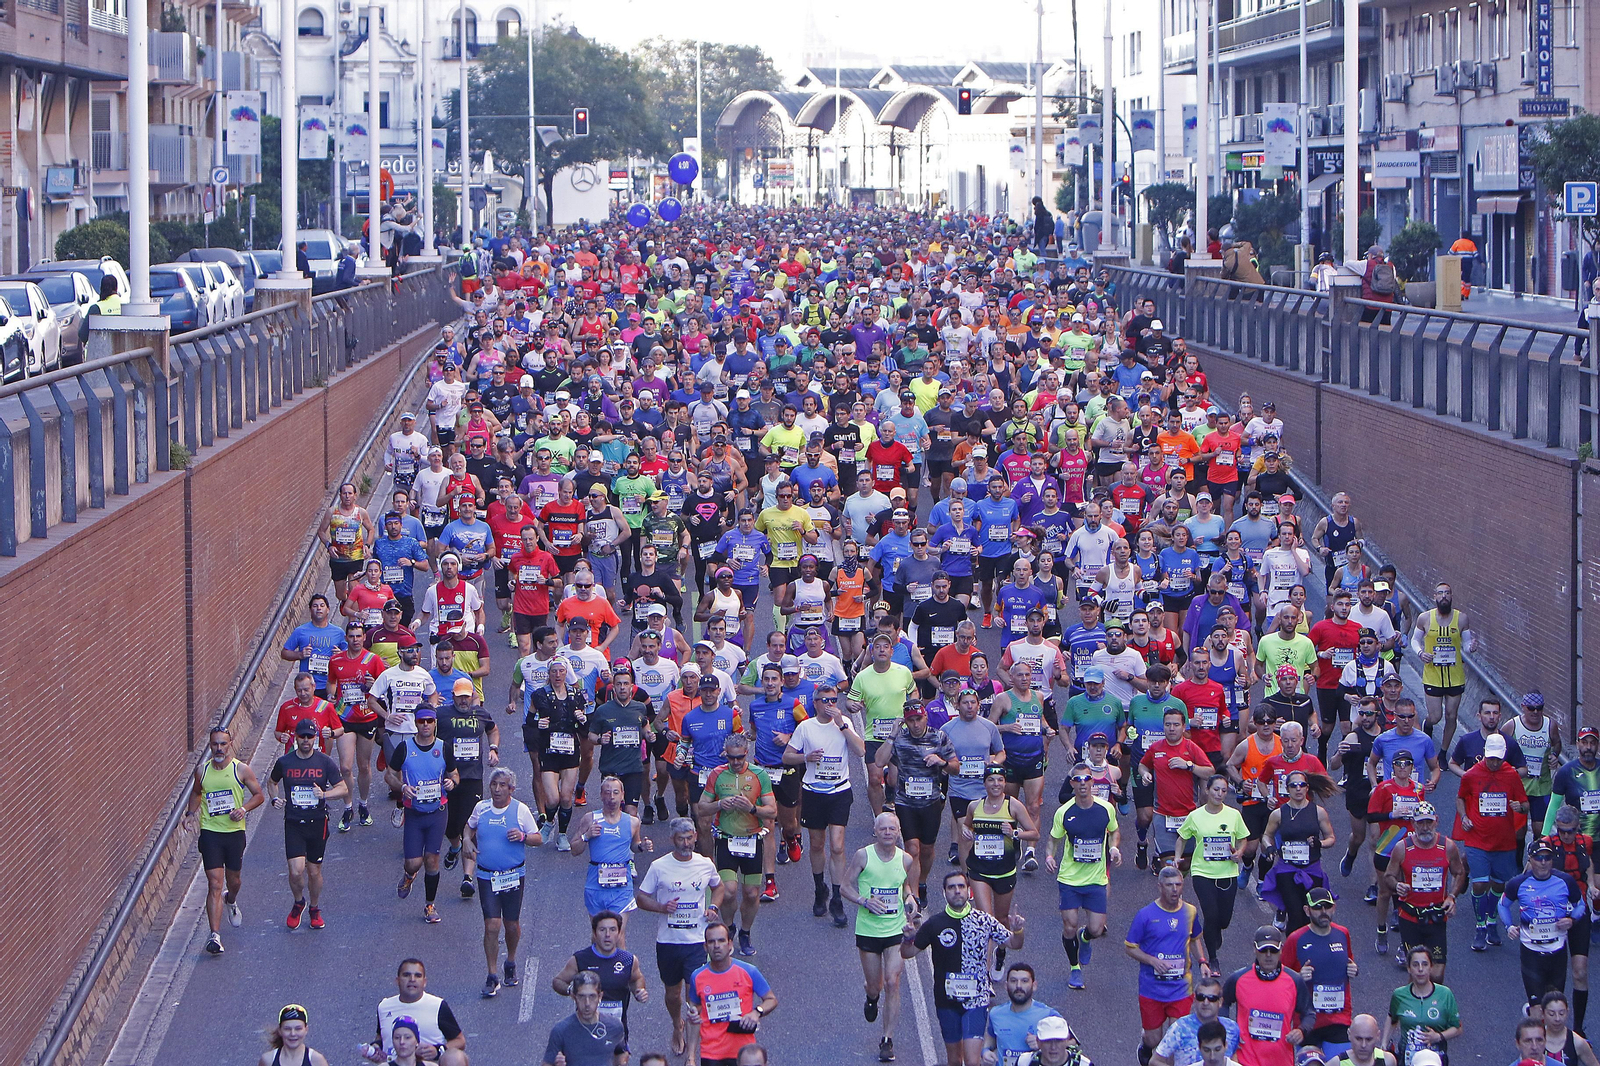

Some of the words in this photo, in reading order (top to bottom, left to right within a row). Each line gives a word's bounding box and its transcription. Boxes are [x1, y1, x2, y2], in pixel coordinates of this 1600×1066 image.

[1525, 103, 1566, 112] HOSTAL
[1571, 186, 1591, 212] P
[309, 636, 331, 647] RUN
[1076, 647, 1089, 656] Club
